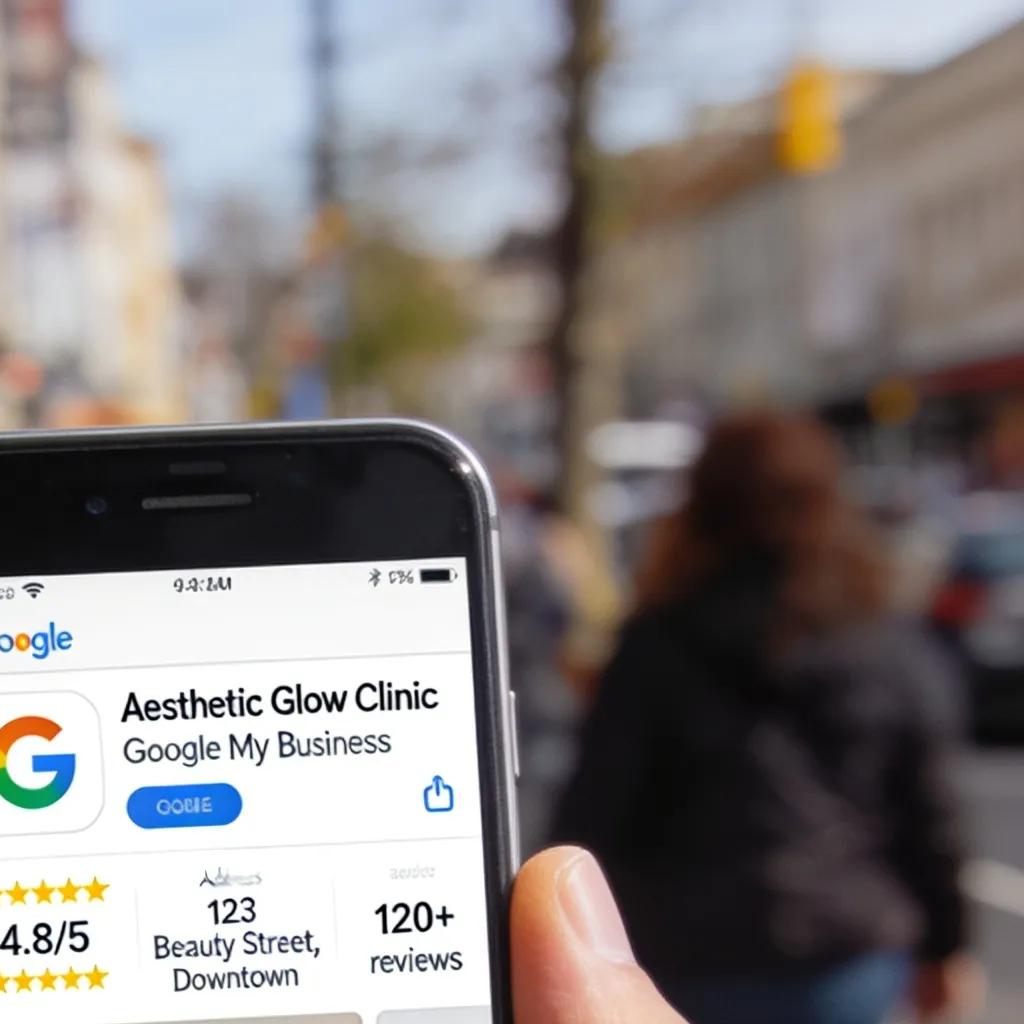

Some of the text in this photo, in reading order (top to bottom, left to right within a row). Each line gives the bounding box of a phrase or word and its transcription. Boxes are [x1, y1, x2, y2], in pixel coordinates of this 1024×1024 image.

[120, 679, 440, 723] Aesthetic Glow Clinic
[123, 730, 393, 768] Google My Business
[207, 896, 258, 926] 123
[374, 900, 456, 935] 120+
[0, 919, 91, 956] 4.8/5
[153, 930, 321, 963] Beauty Street,
[370, 946, 464, 974] reviews
[173, 965, 299, 993] Downtown
